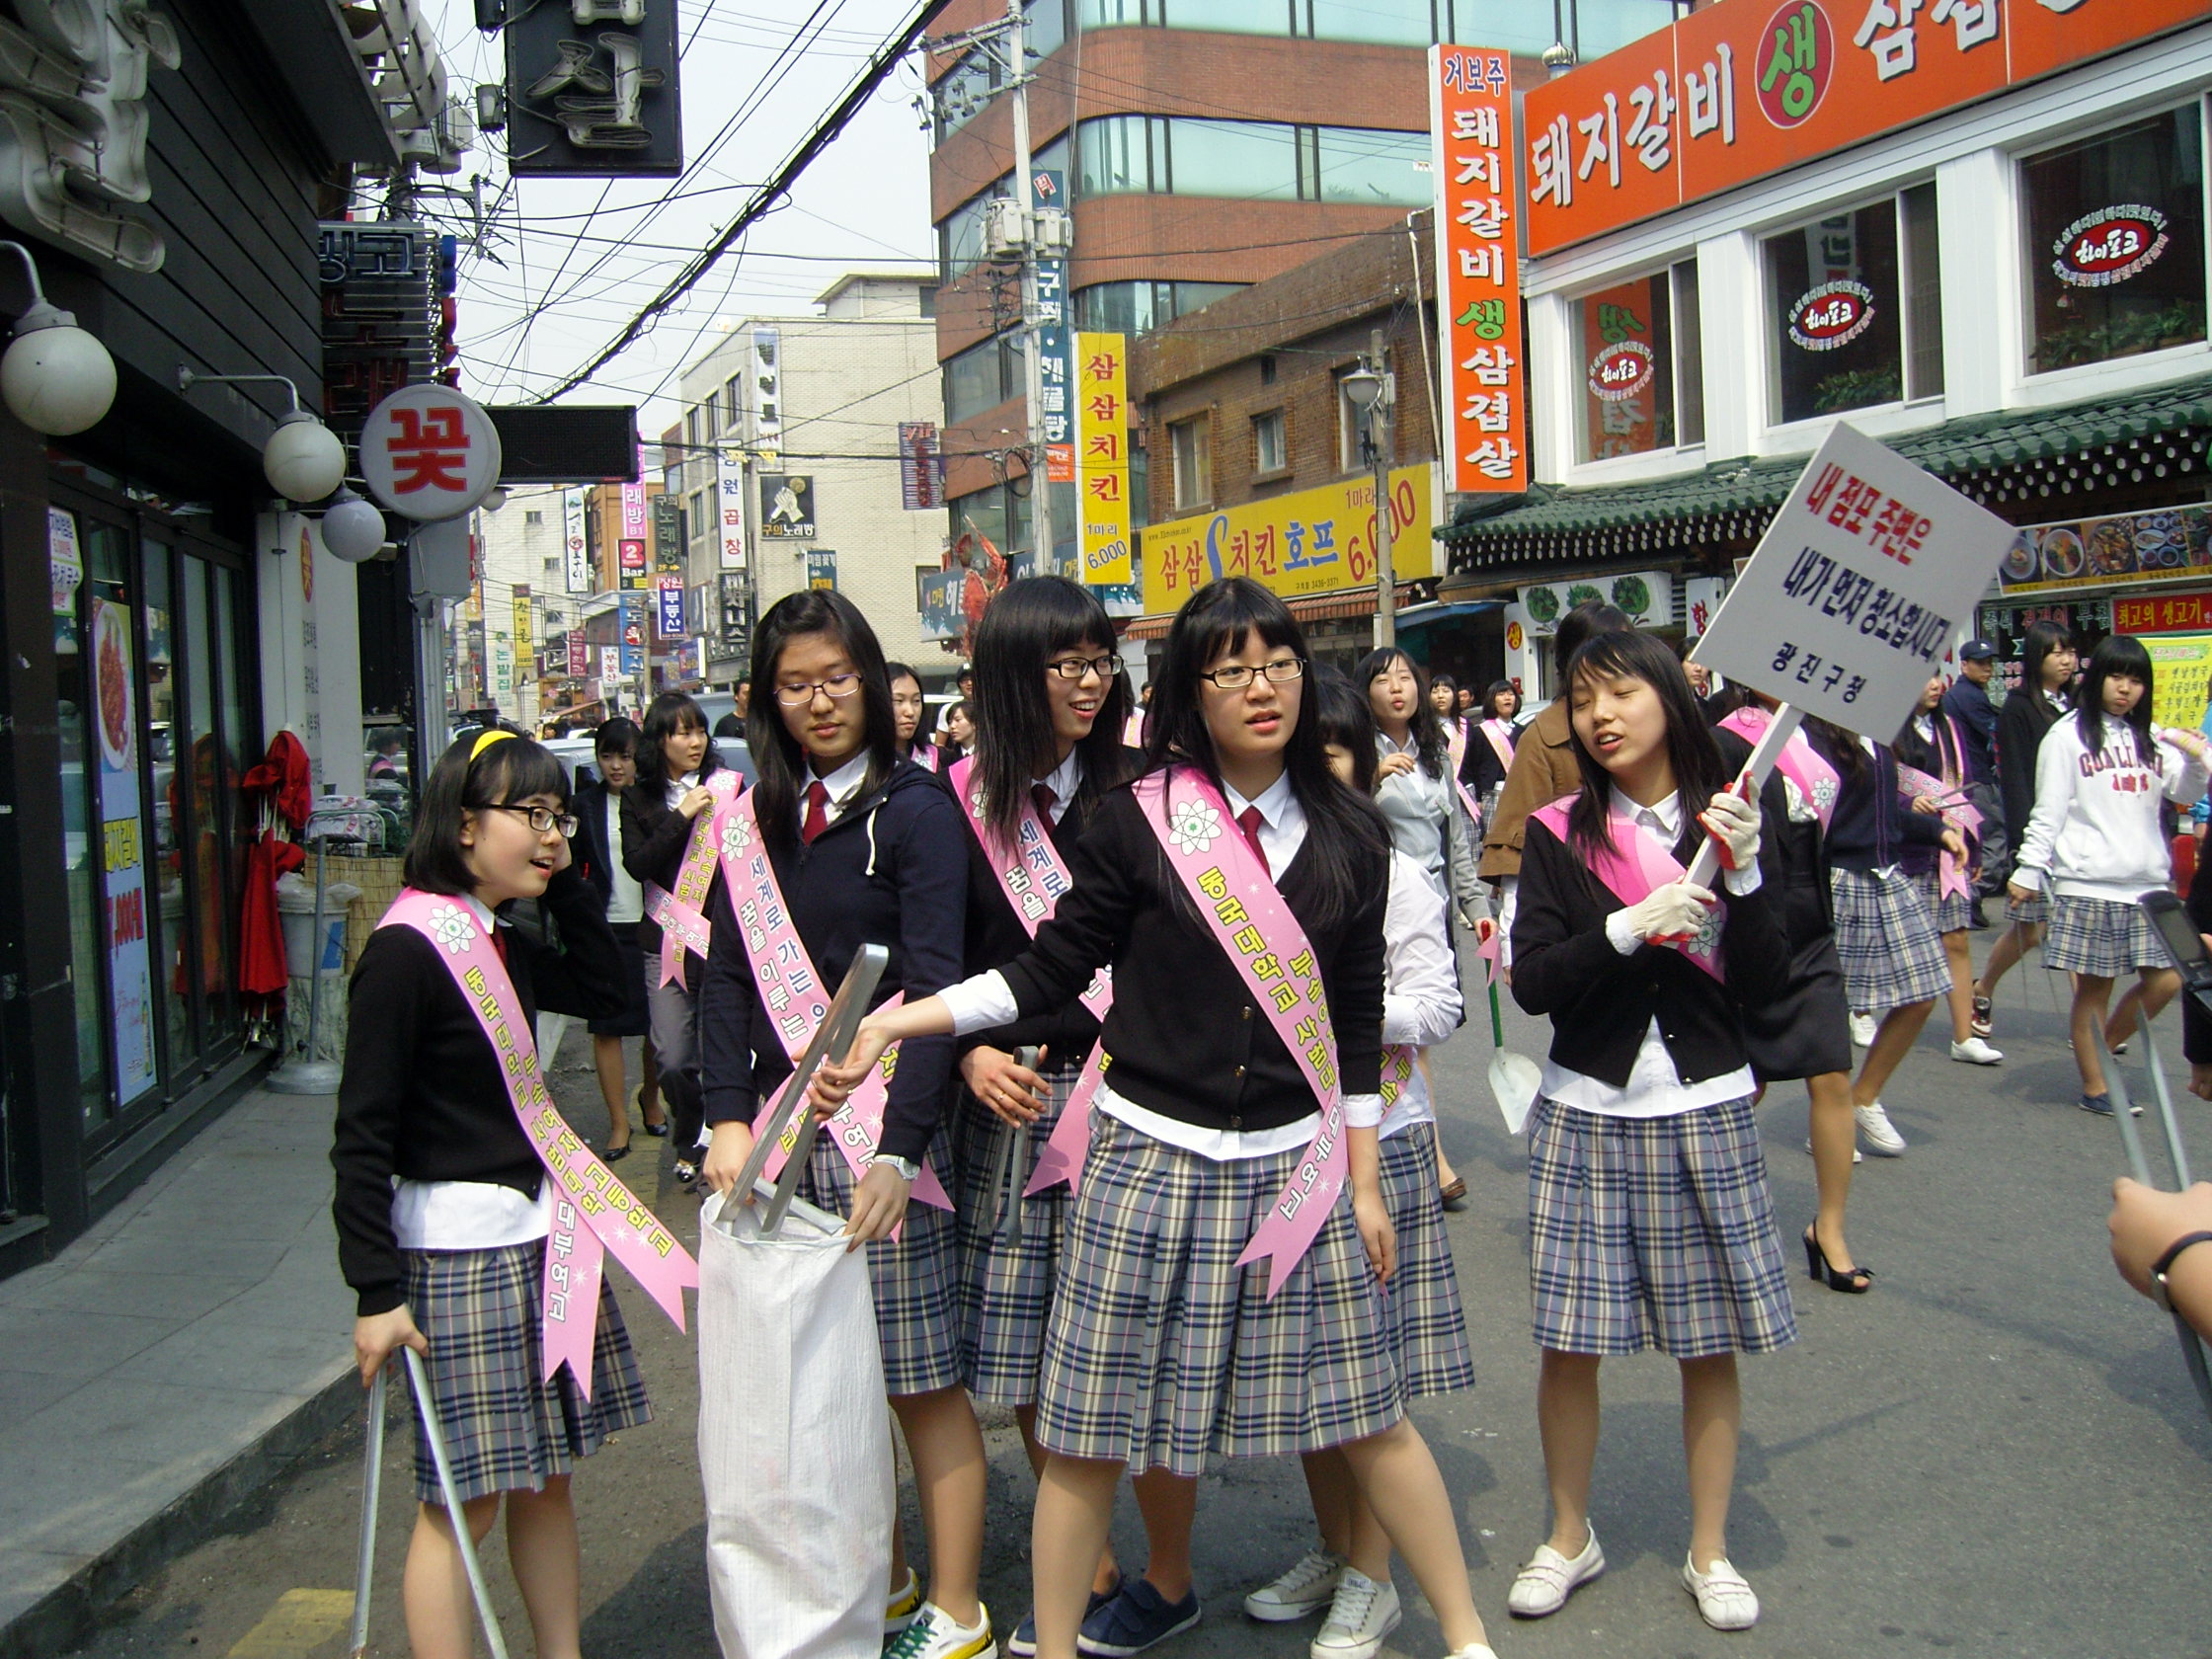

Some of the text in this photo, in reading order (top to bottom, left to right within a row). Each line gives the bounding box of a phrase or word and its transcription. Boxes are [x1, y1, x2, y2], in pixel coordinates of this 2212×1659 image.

[1445, 56, 1506, 98] 거보주
[1531, 42, 1735, 207] 돼지갈비
[1760, 5, 1815, 118] 생
[2075, 228, 2139, 264] 하이포크
[1452, 107, 1518, 480] 돼지갈비 생삼겹살
[1804, 300, 1853, 331] 하이포크
[1601, 358, 1637, 384] 하이포크
[386, 405, 473, 495] 꽃
[1086, 353, 1121, 503] 삼삼치킨
[629, 526, 643, 535] B1
[659, 509, 678, 565] 노래방
[762, 523, 815, 537] 구의노래방
[1086, 523, 1118, 536] 1마리
[1805, 462, 1845, 515] 내
[1868, 499, 1933, 567] 주변은
[621, 568, 644, 578] Bar
[1087, 540, 1128, 570] 6.000
[1160, 540, 1204, 592] 삼삼
[1228, 523, 1278, 579] 치킨
[1283, 520, 1339, 573] 호프
[665, 591, 681, 633] 부동산
[1782, 546, 1837, 607] 내가
[1821, 568, 1875, 626] 먼저
[2118, 597, 2201, 629] 최고의 생고기
[1508, 623, 1521, 649] 생
[1771, 641, 1867, 705] 광진구청
[1019, 820, 1071, 900] 세계로
[1003, 865, 1048, 922] 꿈을
[750, 854, 785, 934] 세계로
[775, 940, 814, 996] 가는
[1196, 867, 1302, 1016] 동국대학교
[739, 897, 810, 1043] 꿈을 이루는
[463, 965, 605, 1218] 동국대학교 사범대학
[523, 1049, 675, 1259] 부속여자 고등학교
